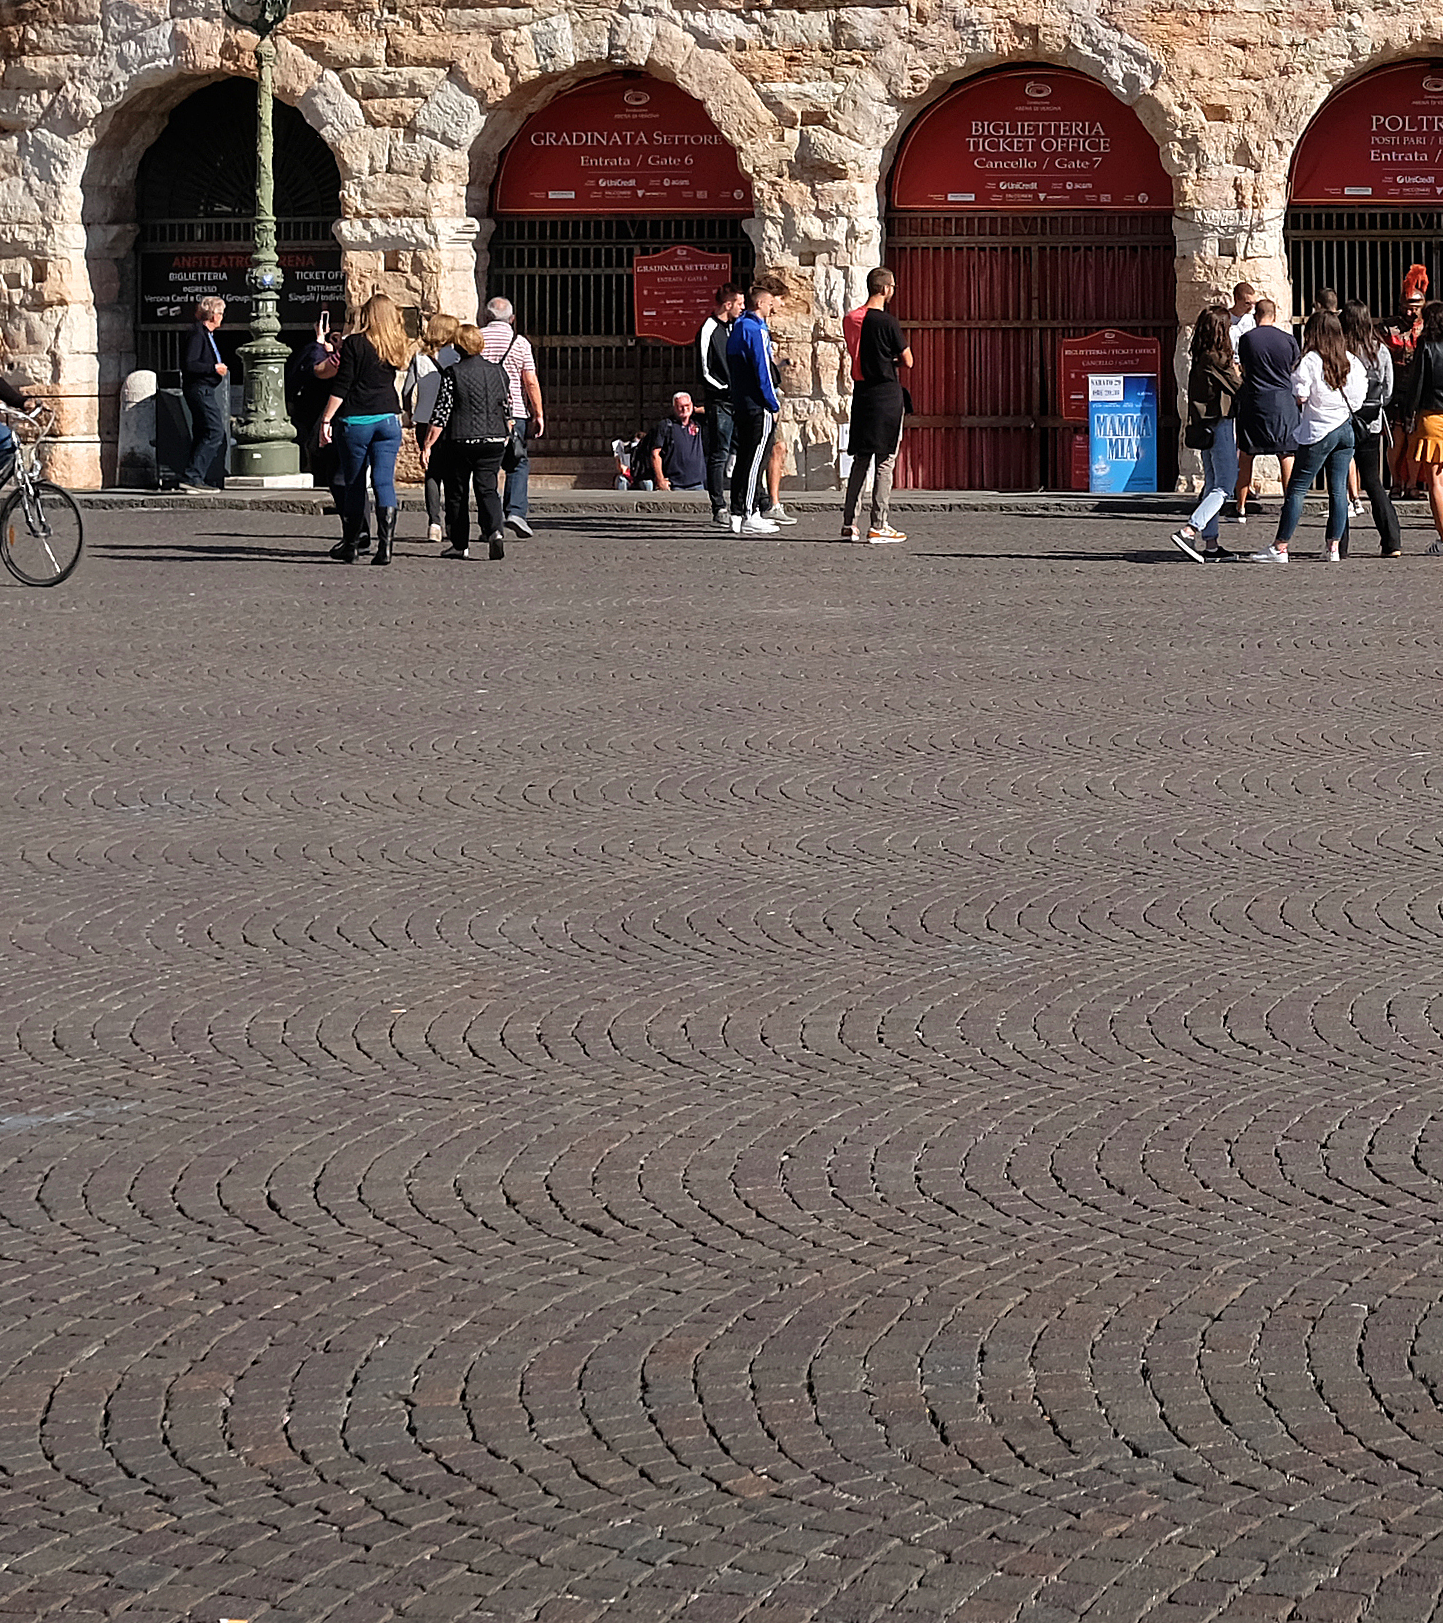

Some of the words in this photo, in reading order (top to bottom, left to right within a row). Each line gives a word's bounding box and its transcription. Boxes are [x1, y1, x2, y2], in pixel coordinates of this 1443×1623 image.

[970, 121, 1105, 136] BIGLIETTERIA
[530, 131, 649, 146] GRADINATA
[1371, 136, 1400, 145] POSTI
[1403, 136, 1426, 145] PARI
[965, 137, 1036, 153] TICKET
[1041, 137, 1111, 153] OFFICE
[580, 155, 631, 167] Entrata
[648, 154, 682, 167] Gate
[684, 154, 694, 166] 6
[1370, 149, 1428, 162] Entrata
[974, 157, 1037, 169] Cancello
[1055, 157, 1090, 169] Gate
[1092, 157, 1102, 169] 7
[607, 179, 636, 187] UniCredit
[1007, 181, 1038, 189] UniCredit
[168, 272, 228, 281] BIGLIETTERIA
[294, 271, 326, 280] TICKET
[171, 294, 188, 302] Card
[1094, 413, 1153, 438] MAMMA
